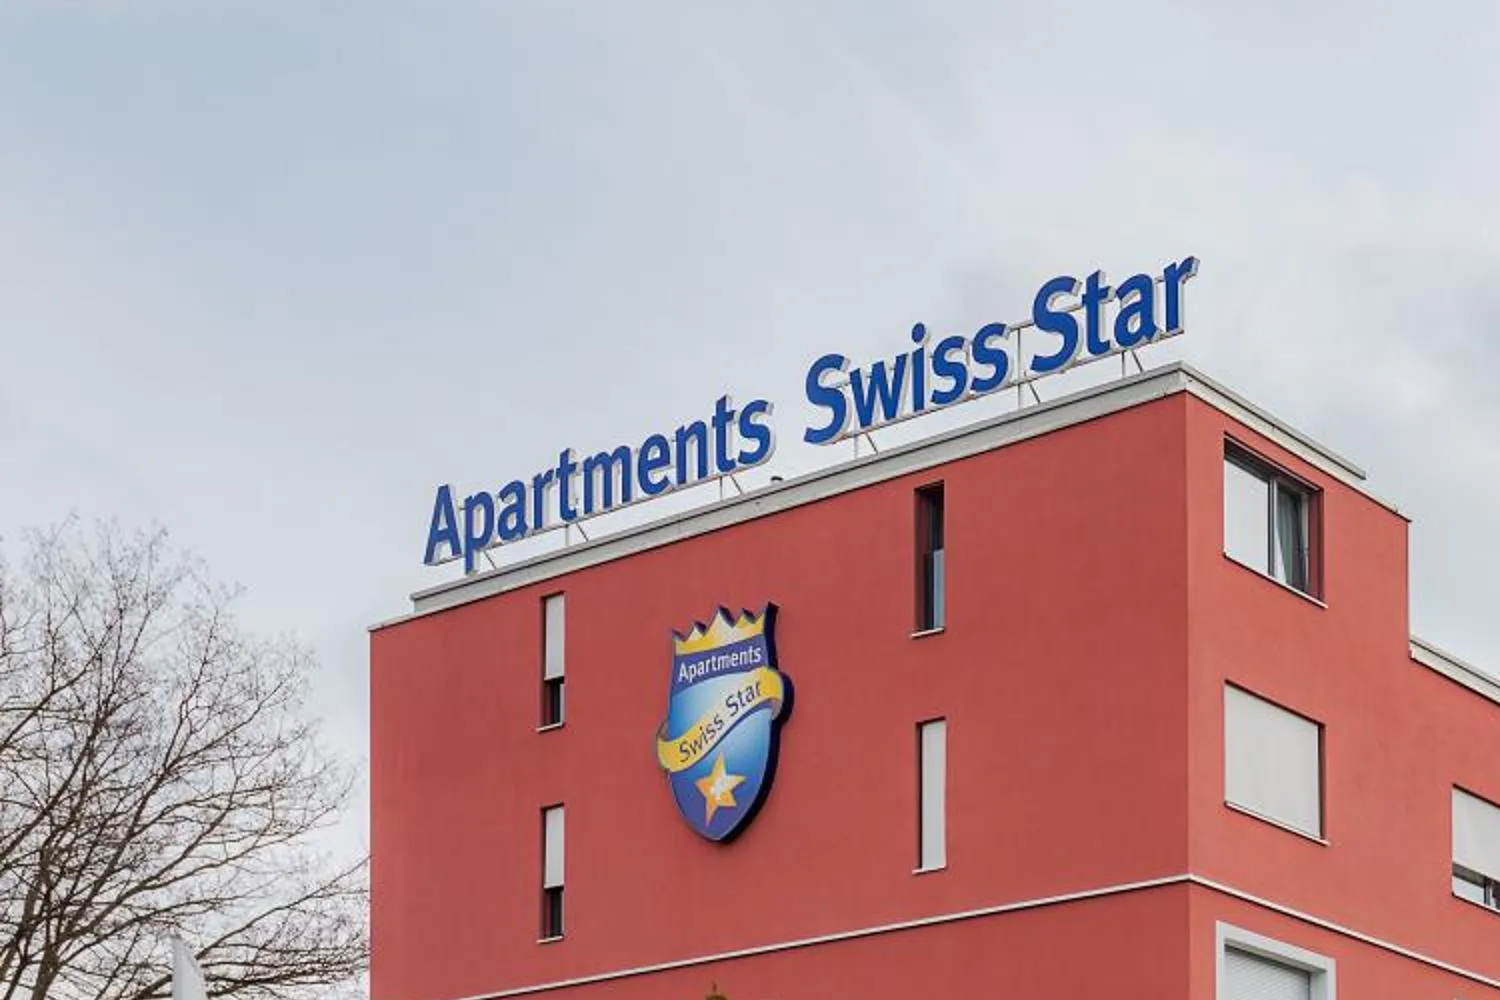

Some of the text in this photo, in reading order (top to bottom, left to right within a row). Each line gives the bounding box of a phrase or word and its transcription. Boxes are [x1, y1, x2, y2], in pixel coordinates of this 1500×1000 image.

[424, 255, 1200, 575] Apartments Swiss Star
[679, 645, 762, 683] Apartments
[679, 681, 761, 763] Swiss Star
